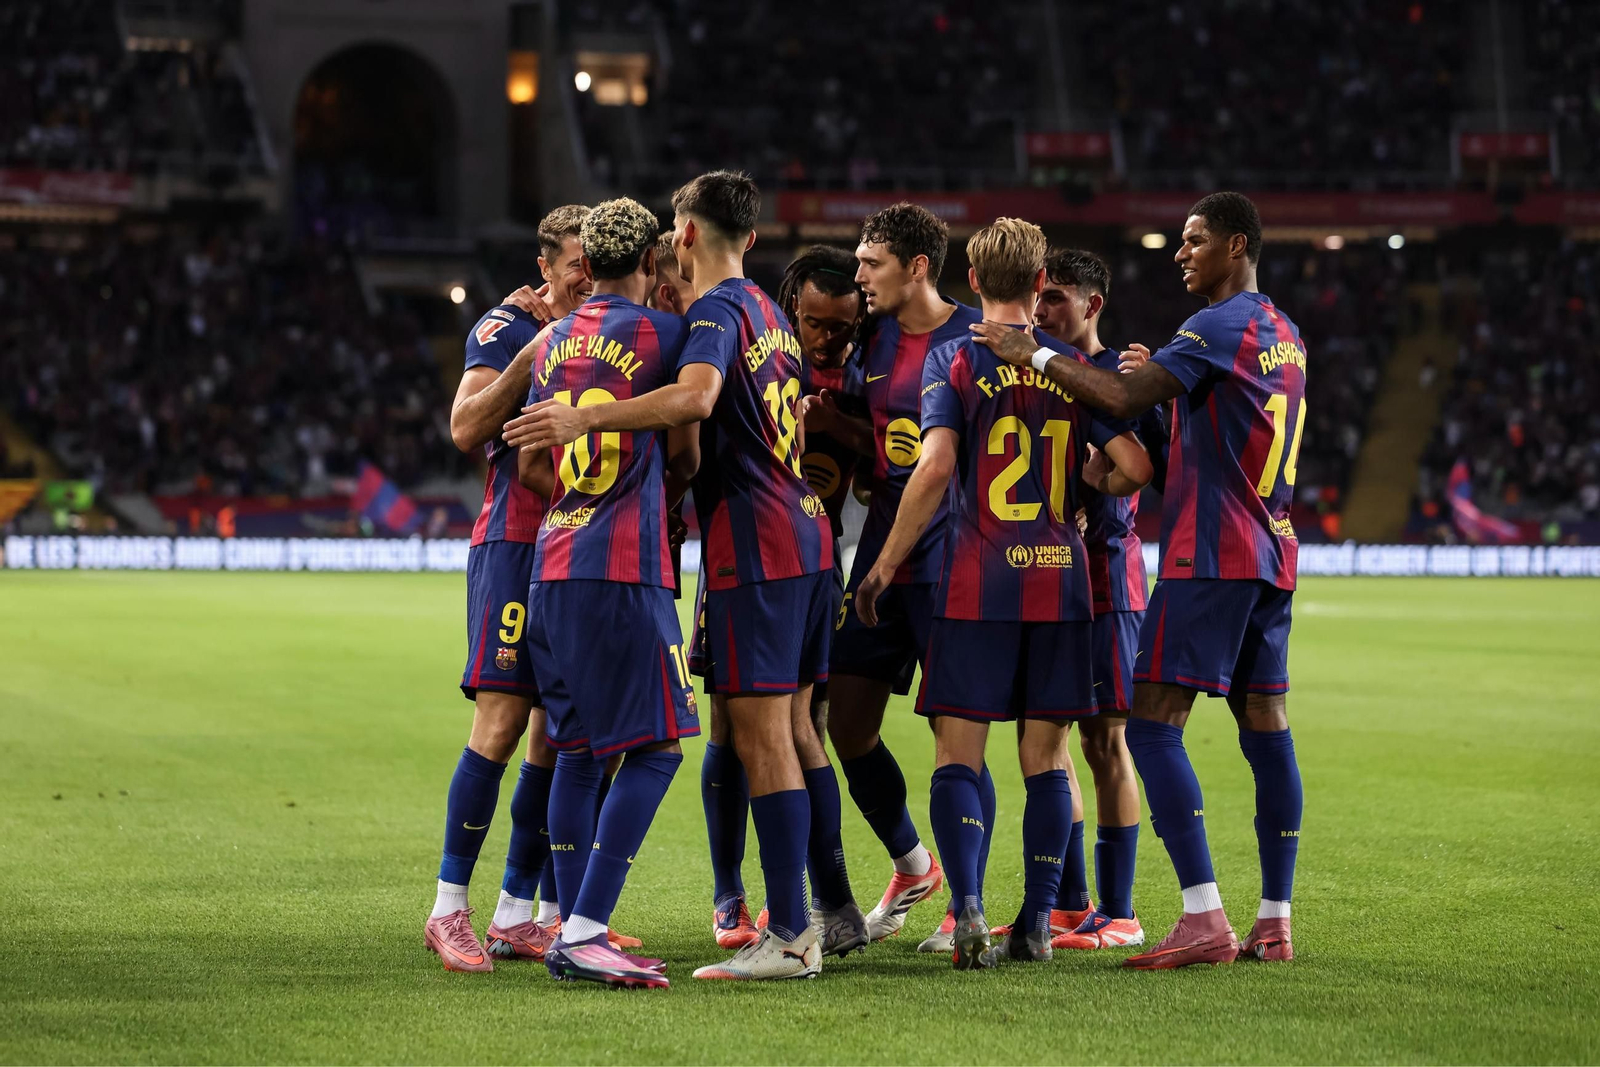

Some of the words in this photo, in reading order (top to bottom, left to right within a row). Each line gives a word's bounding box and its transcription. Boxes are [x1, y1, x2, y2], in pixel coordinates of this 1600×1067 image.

[538, 335, 585, 387] LAMINE
[586, 335, 643, 381] YAMAL
[976, 376, 1001, 398] F.
[553, 388, 620, 496] 10
[987, 415, 1071, 524] 21
[1035, 546, 1072, 555] UNHCR
[1036, 555, 1073, 564] ACNUR
[499, 601, 526, 644] 9
